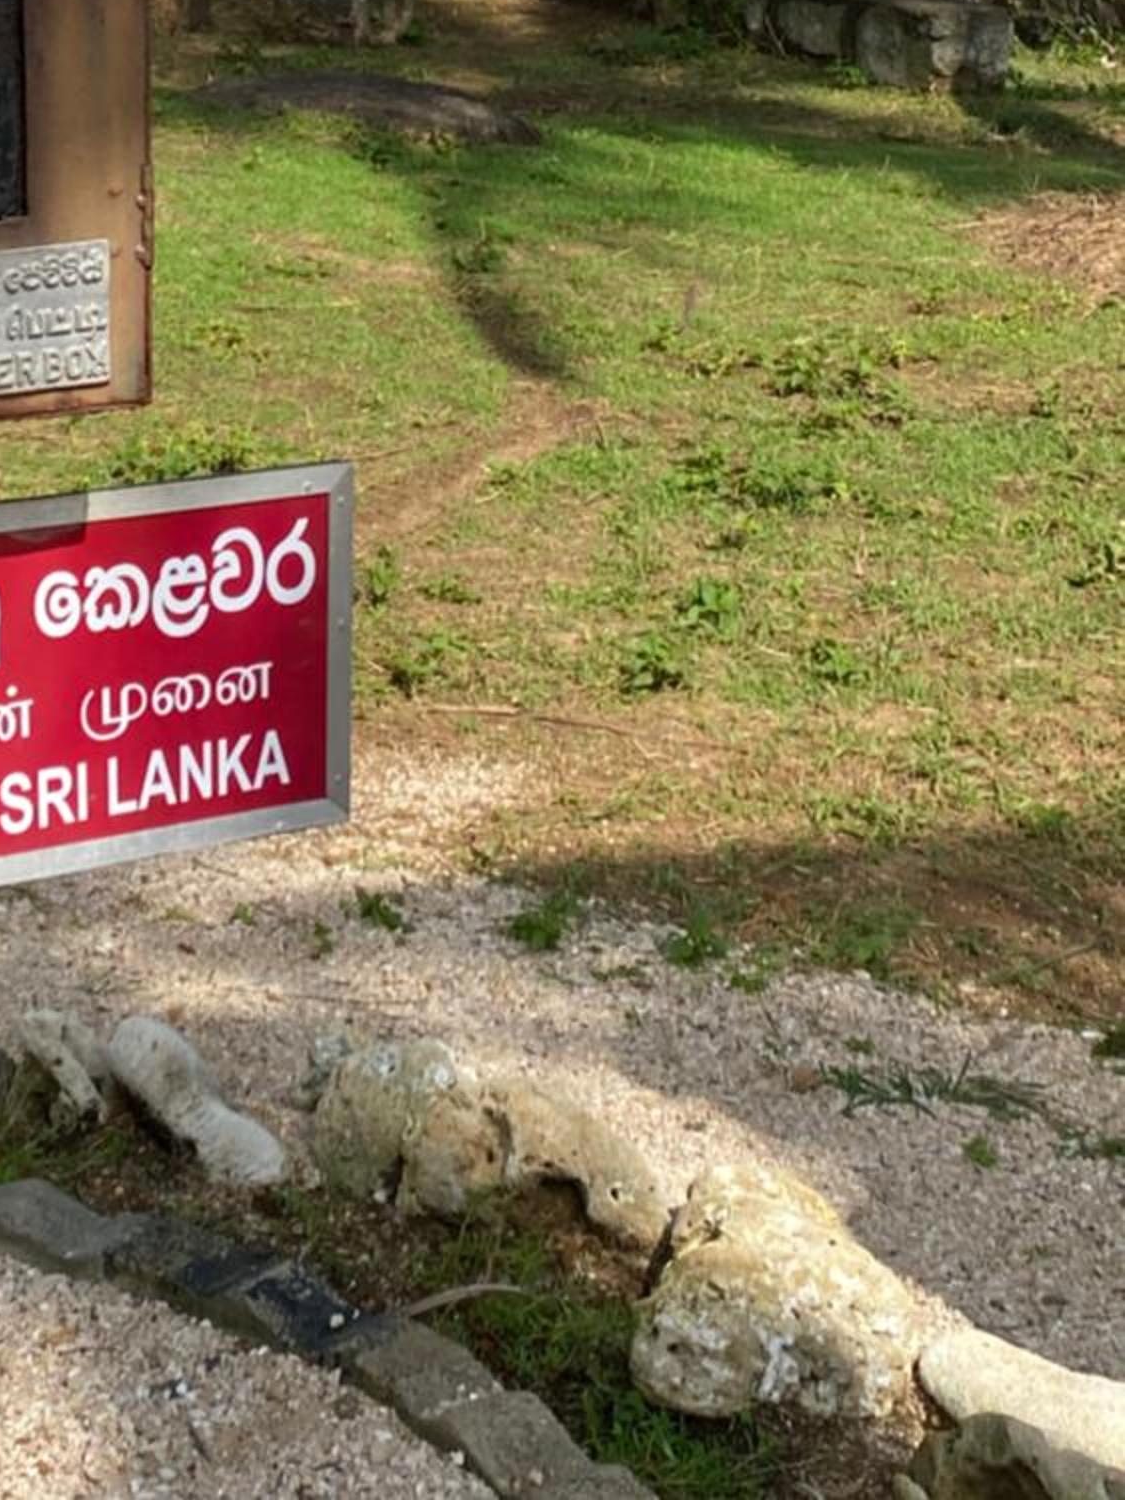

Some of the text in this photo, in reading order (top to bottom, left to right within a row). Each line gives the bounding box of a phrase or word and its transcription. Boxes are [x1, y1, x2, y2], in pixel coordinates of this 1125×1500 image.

[41, 340, 110, 384] BOX
[33, 516, 317, 639] කෙළවර
[80, 661, 273, 742] முனை
[106, 729, 291, 817] LANKA
